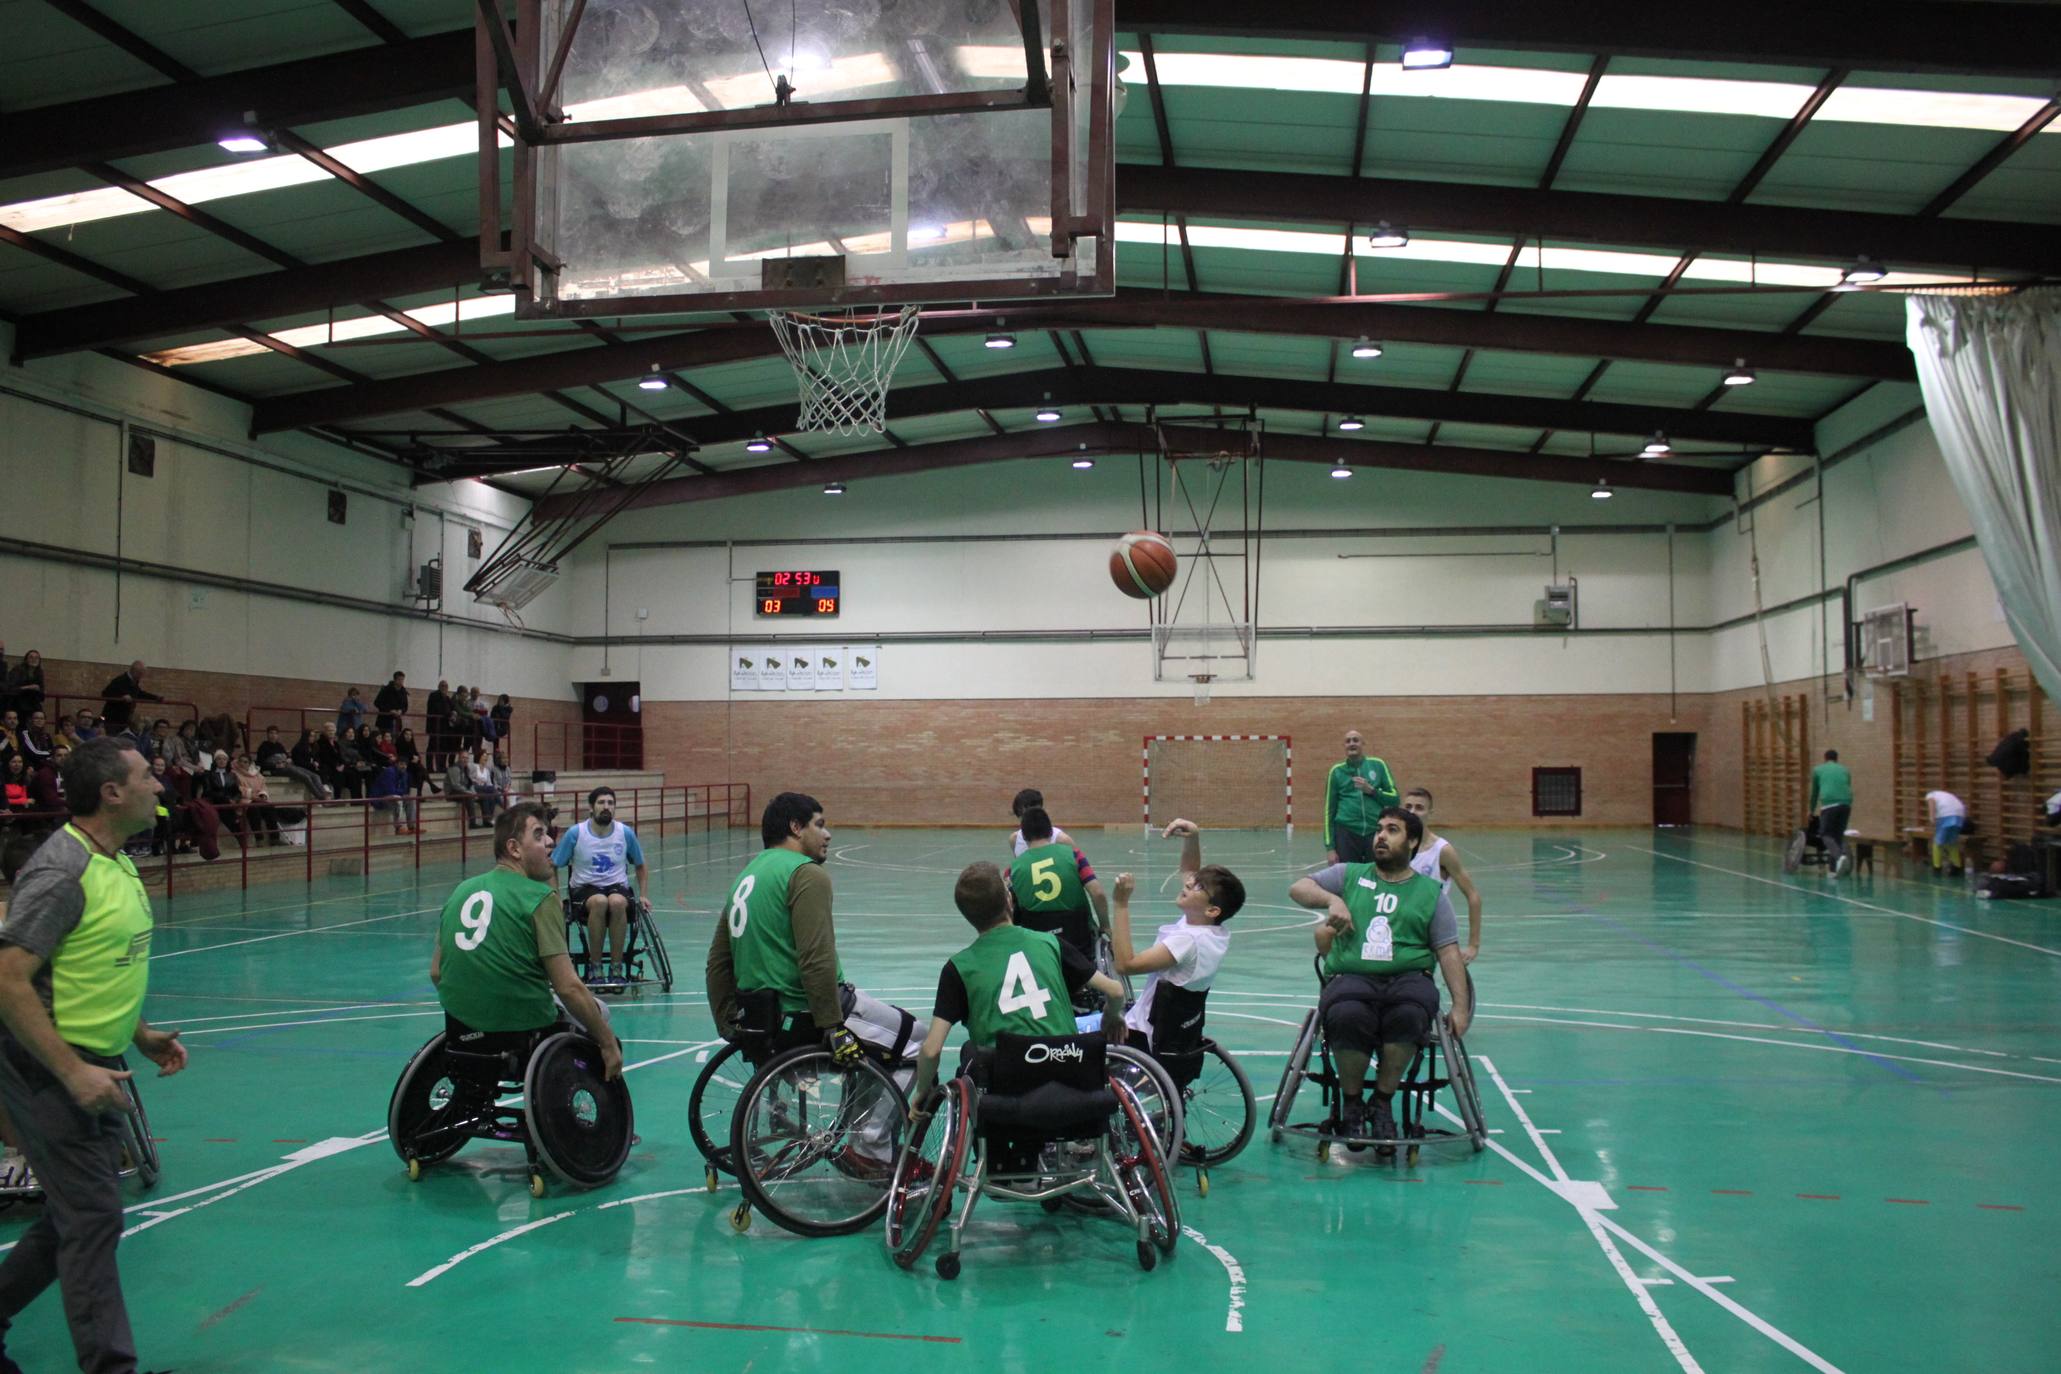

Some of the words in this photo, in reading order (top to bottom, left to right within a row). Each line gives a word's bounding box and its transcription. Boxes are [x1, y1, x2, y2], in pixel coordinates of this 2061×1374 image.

[764, 599, 781, 613] 03
[1031, 856, 1062, 901] 5
[1373, 892, 1399, 914] 10
[455, 890, 494, 950] 9
[729, 874, 755, 938] 8
[998, 951, 1051, 1020] 4
